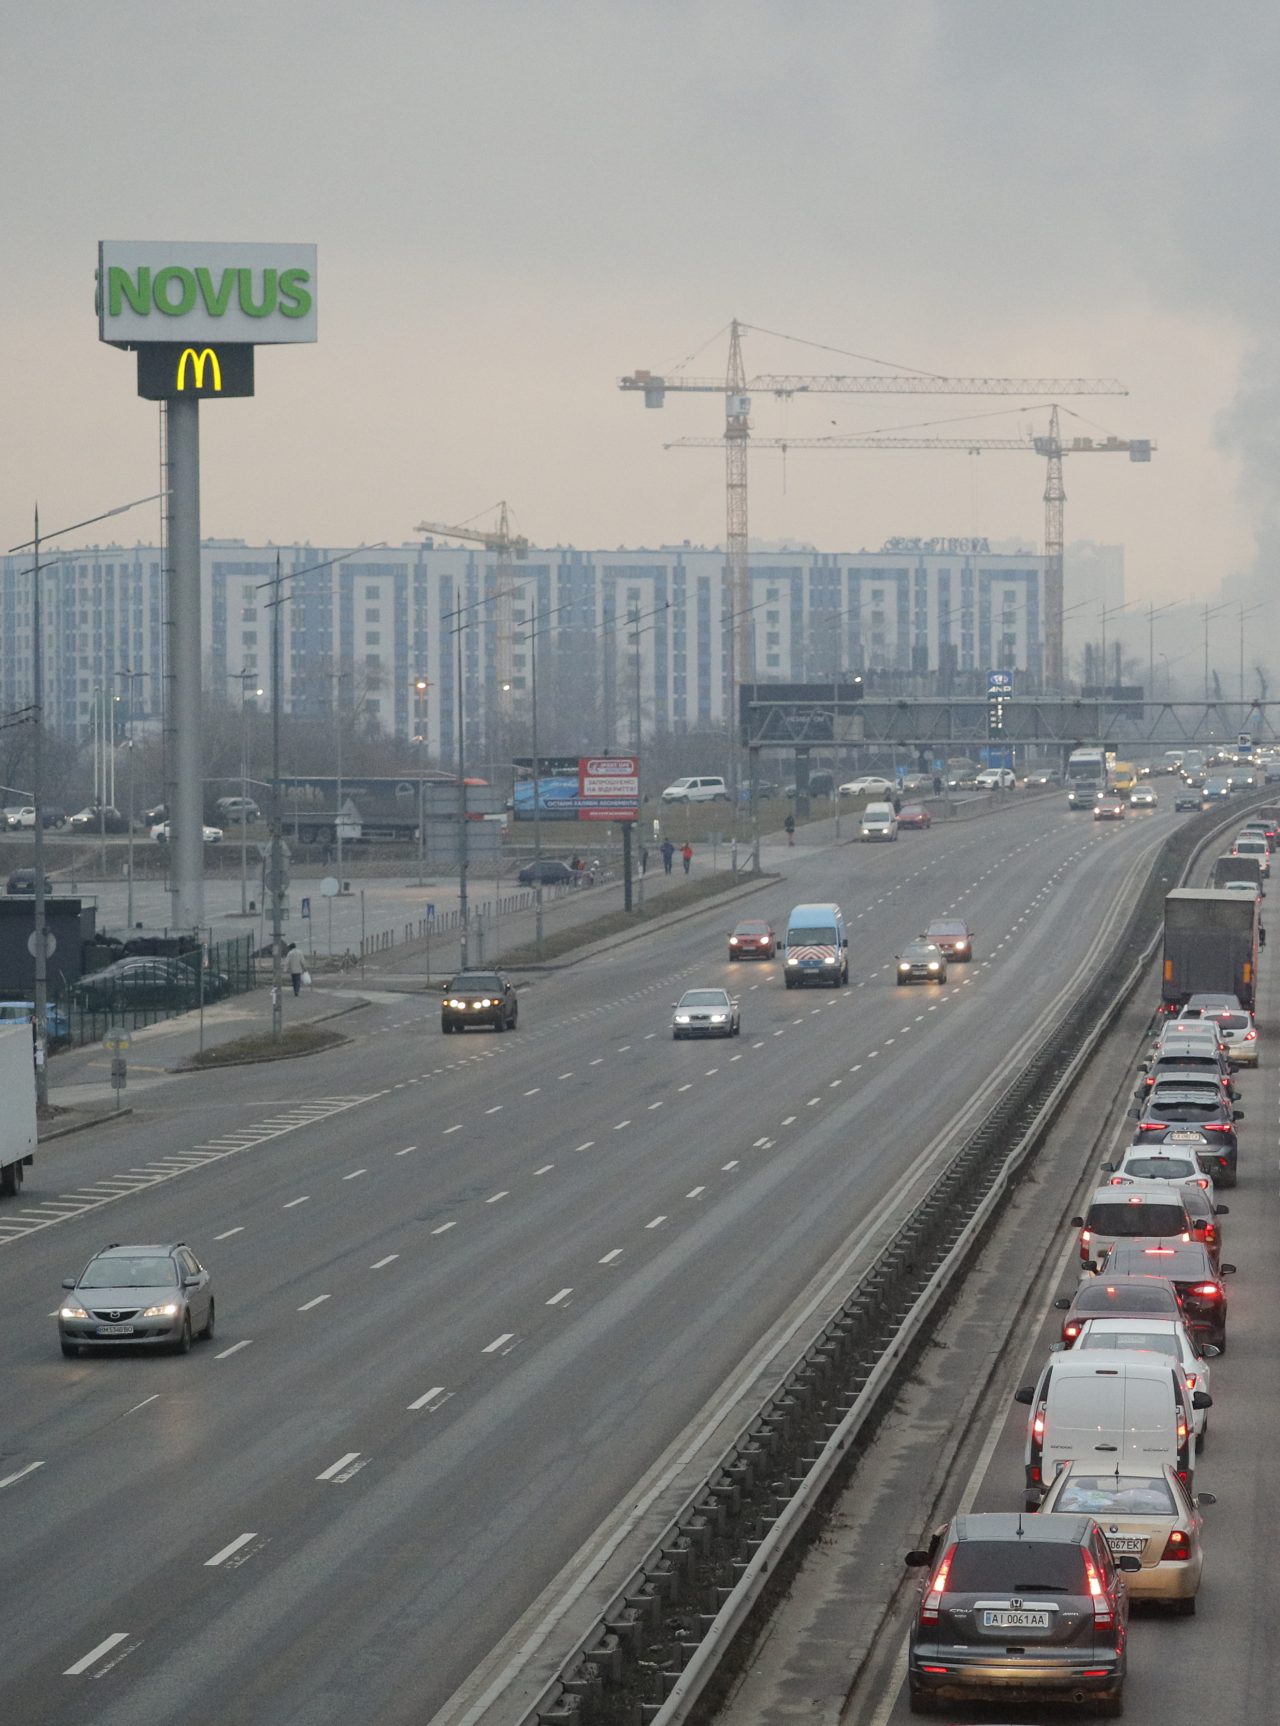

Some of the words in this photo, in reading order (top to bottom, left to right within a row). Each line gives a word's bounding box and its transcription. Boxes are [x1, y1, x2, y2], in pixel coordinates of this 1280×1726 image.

[108, 266, 312, 318] NOVUS
[1126, 1540, 1140, 1550] EK
[1007, 1614, 1029, 1625] 0061
[1030, 1615, 1045, 1625] AA
